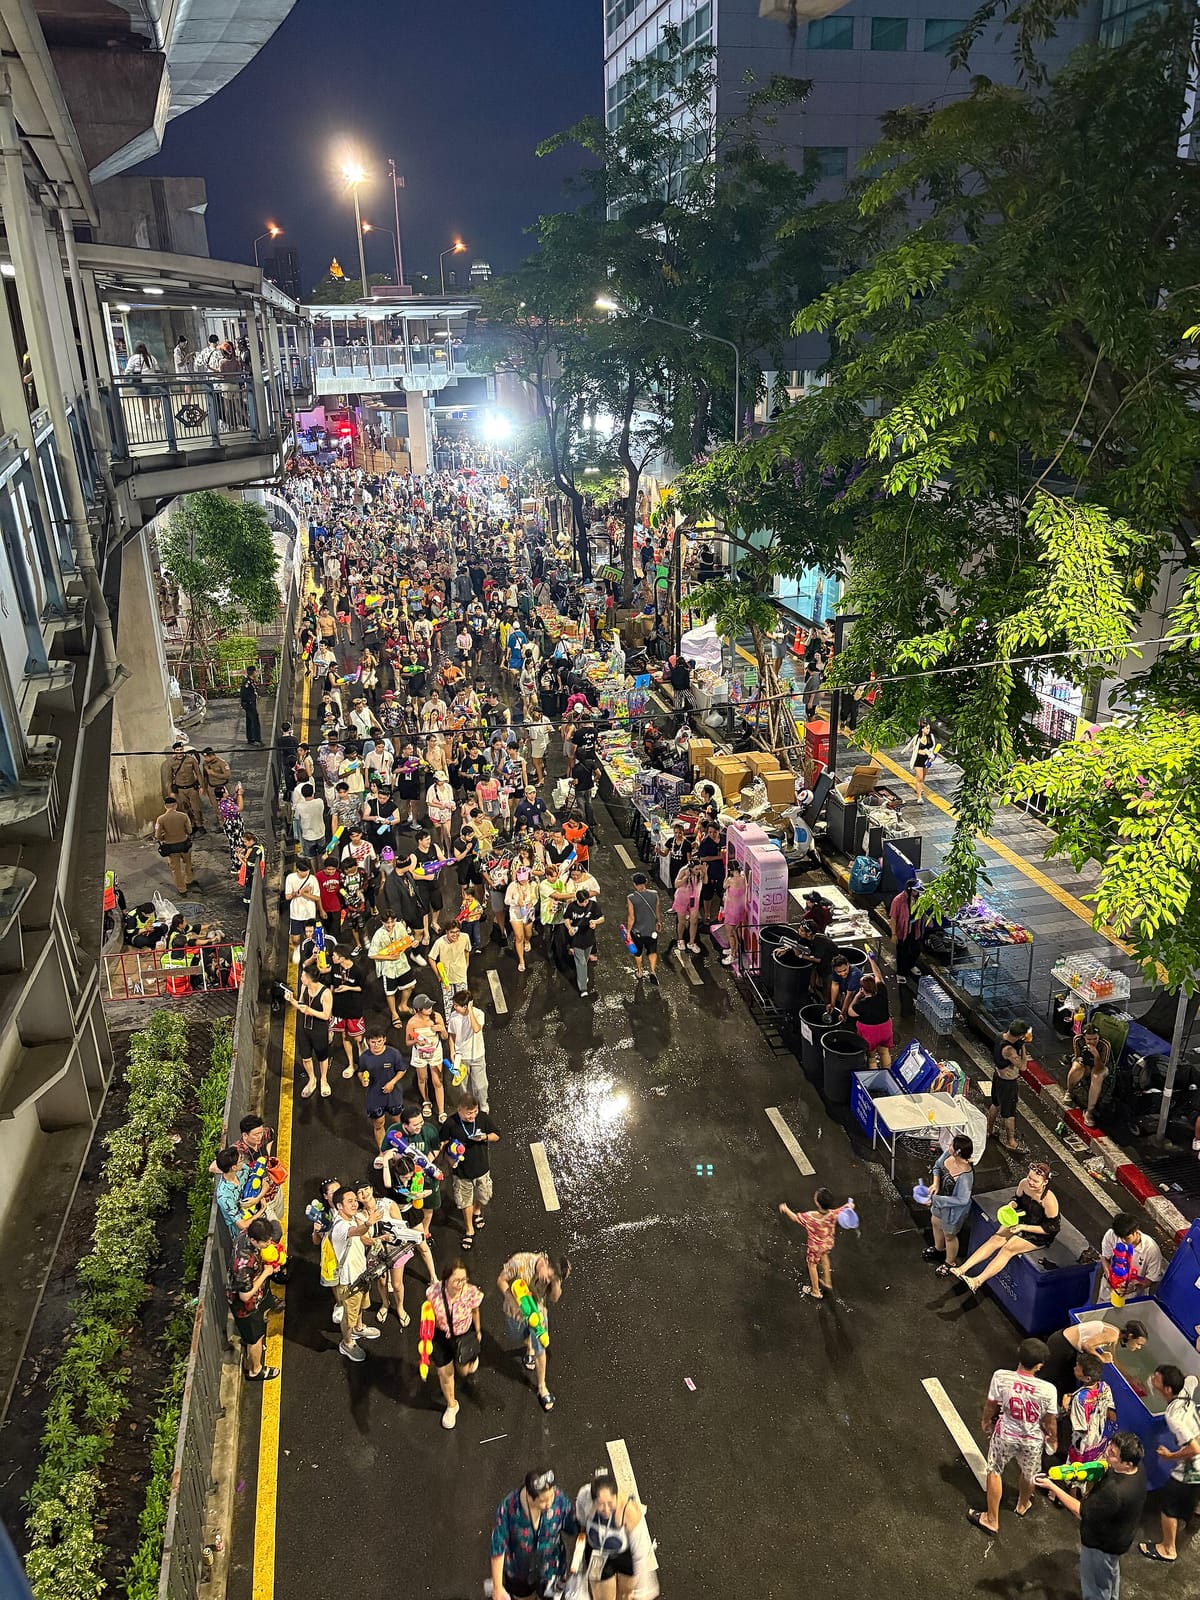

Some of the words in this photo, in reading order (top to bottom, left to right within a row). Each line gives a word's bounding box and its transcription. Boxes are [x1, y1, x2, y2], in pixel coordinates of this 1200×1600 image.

[604, 570, 617, 580] 100
[762, 893, 784, 906] 3D
[1009, 1397, 1039, 1423] 66
